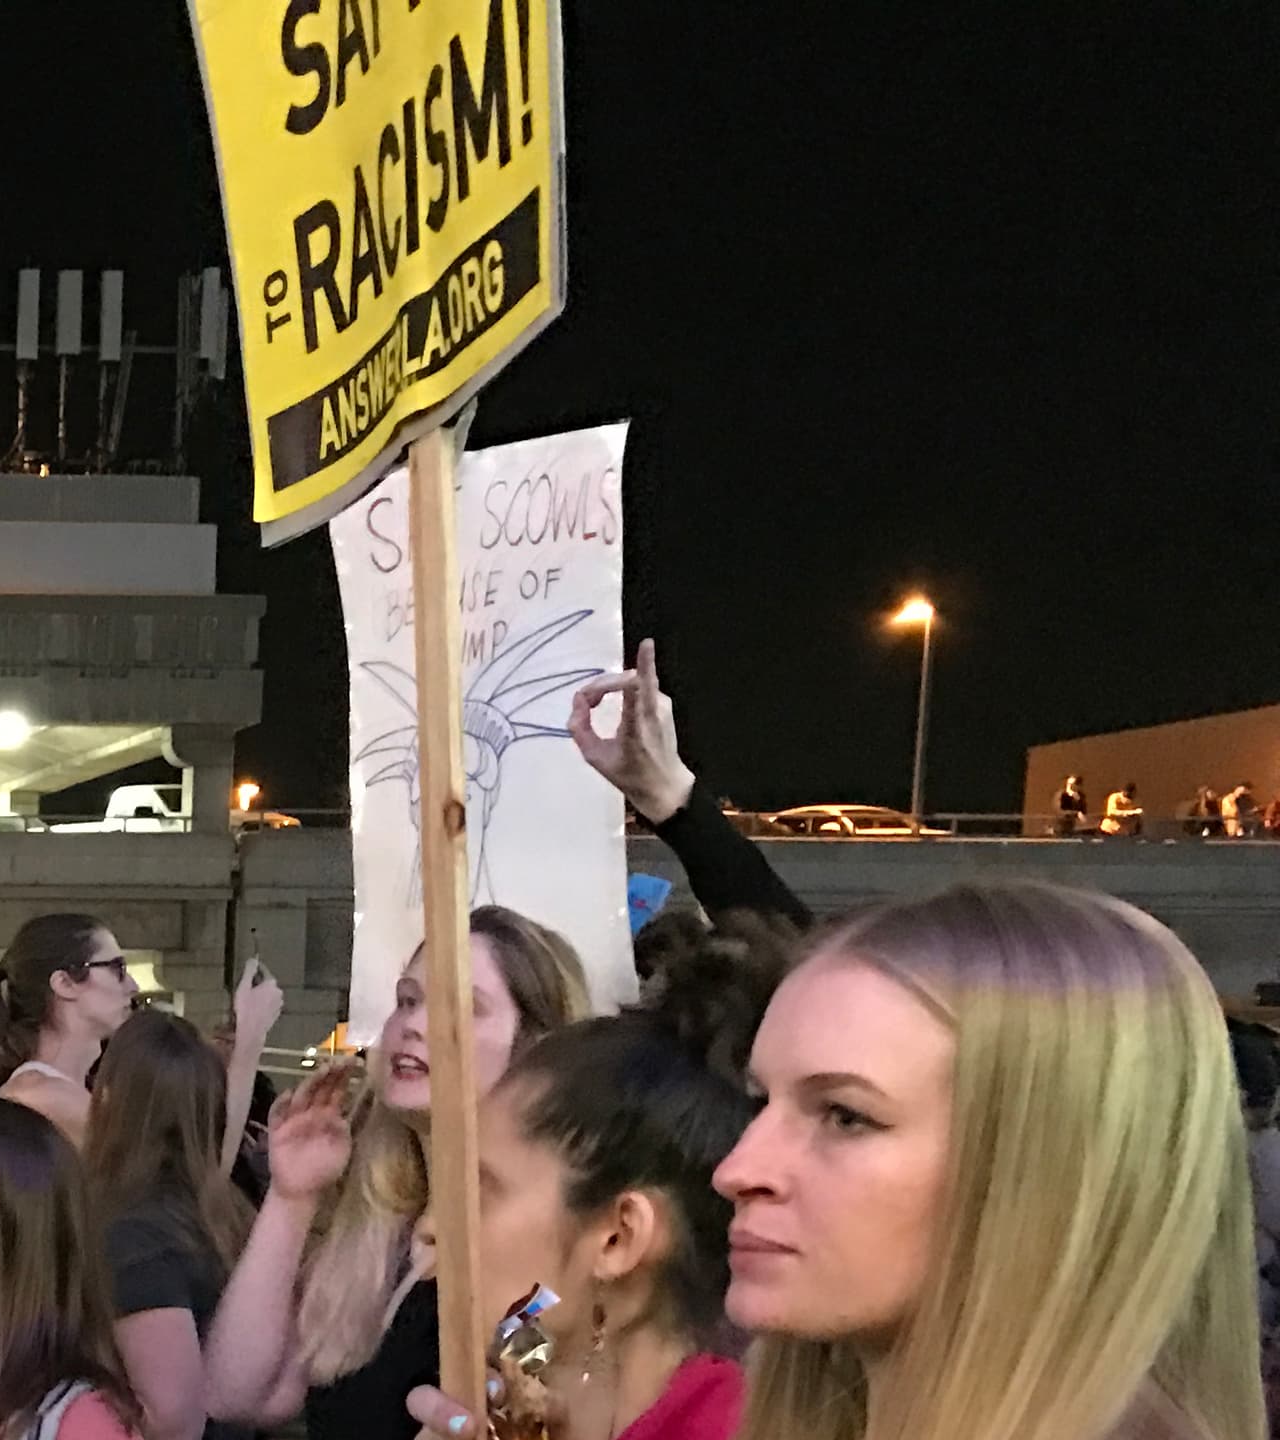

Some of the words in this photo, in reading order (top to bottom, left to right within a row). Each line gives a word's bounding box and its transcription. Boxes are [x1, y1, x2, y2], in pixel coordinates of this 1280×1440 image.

[263, 269, 292, 344] TO
[293, 0, 533, 354] RACISM!
[480, 467, 618, 550] SCOWLS
[519, 568, 561, 600] OF
